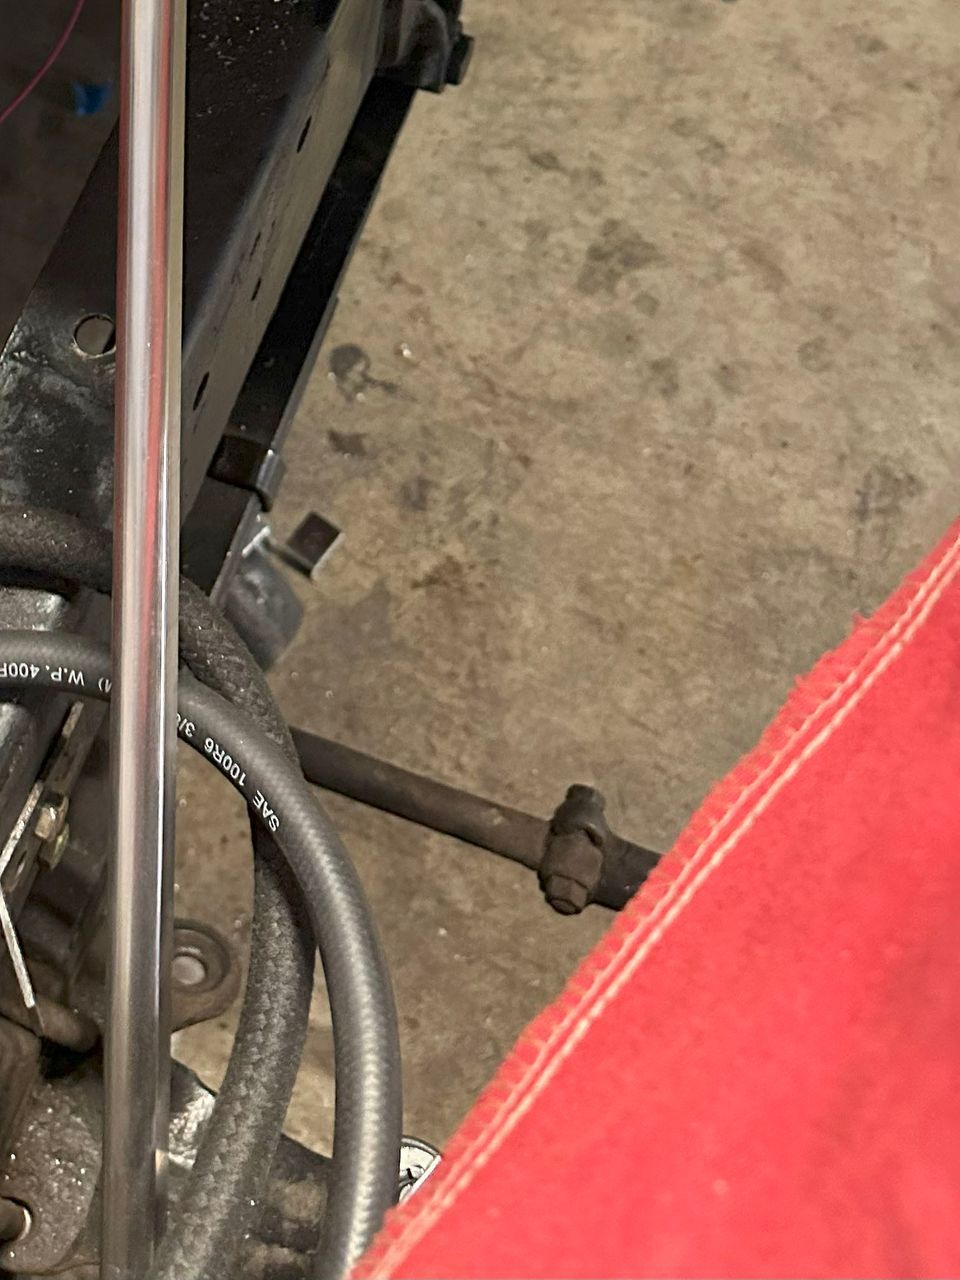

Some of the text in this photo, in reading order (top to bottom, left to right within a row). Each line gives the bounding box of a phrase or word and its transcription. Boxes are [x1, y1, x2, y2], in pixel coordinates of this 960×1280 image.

[44, 664, 86, 687] W.P.
[203, 737, 247, 787] 100R6
[252, 789, 280, 832] SAE
